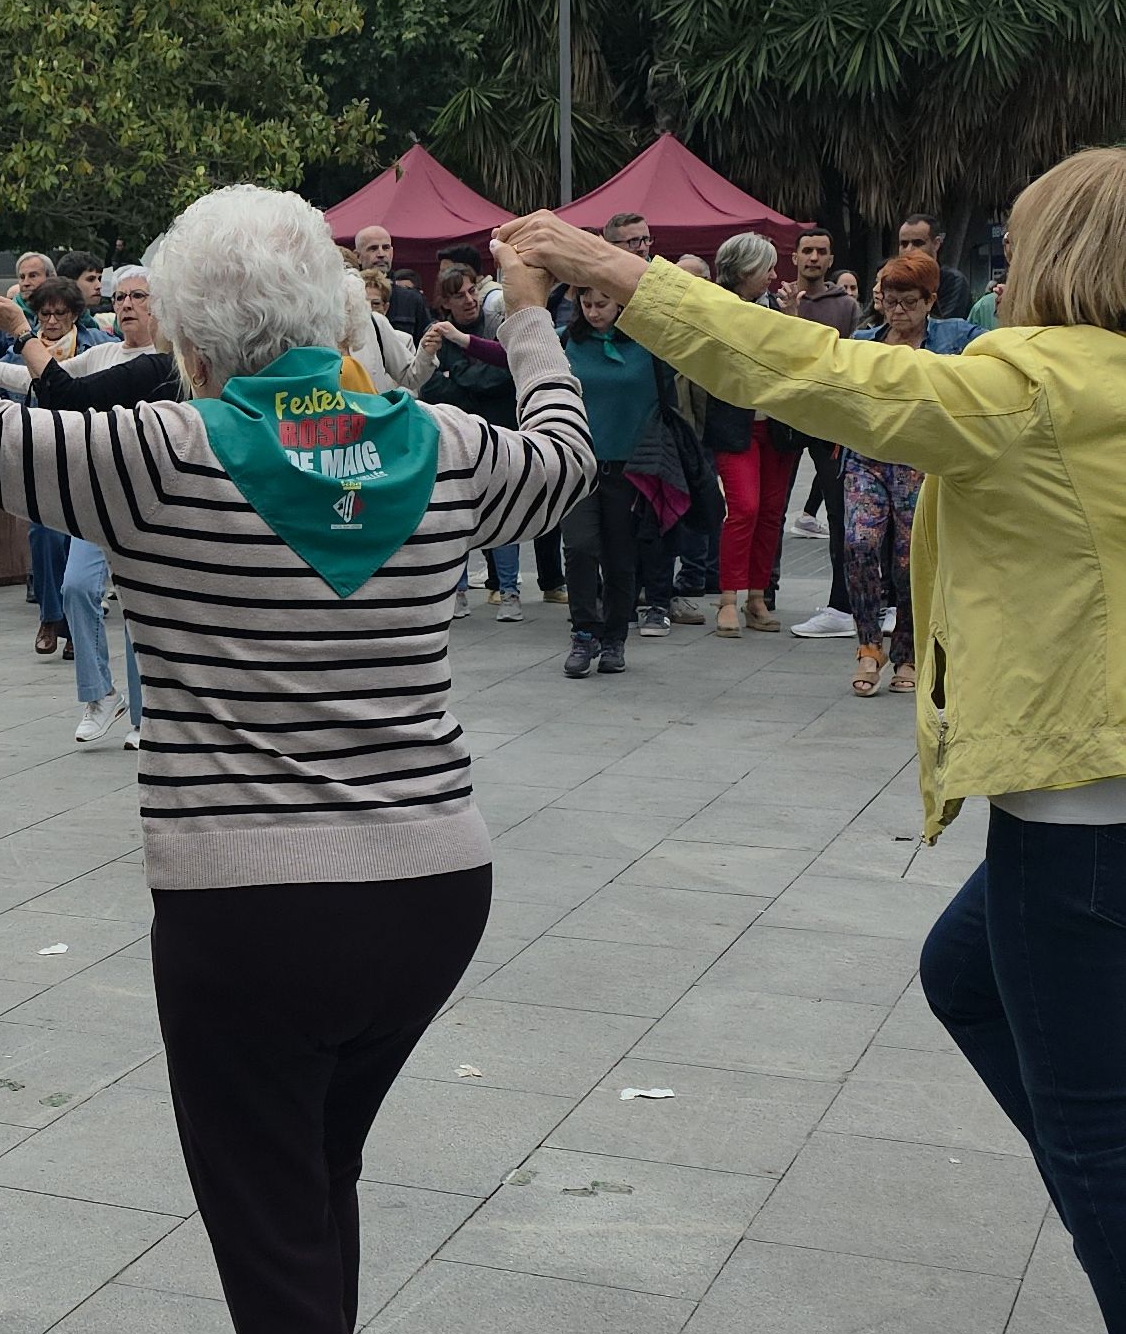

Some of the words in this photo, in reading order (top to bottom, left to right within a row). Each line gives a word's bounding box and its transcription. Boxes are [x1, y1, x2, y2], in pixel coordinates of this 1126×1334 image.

[275, 387, 346, 420] Festes
[278, 414, 367, 449] ROSER
[320, 440, 382, 479] MAIG
